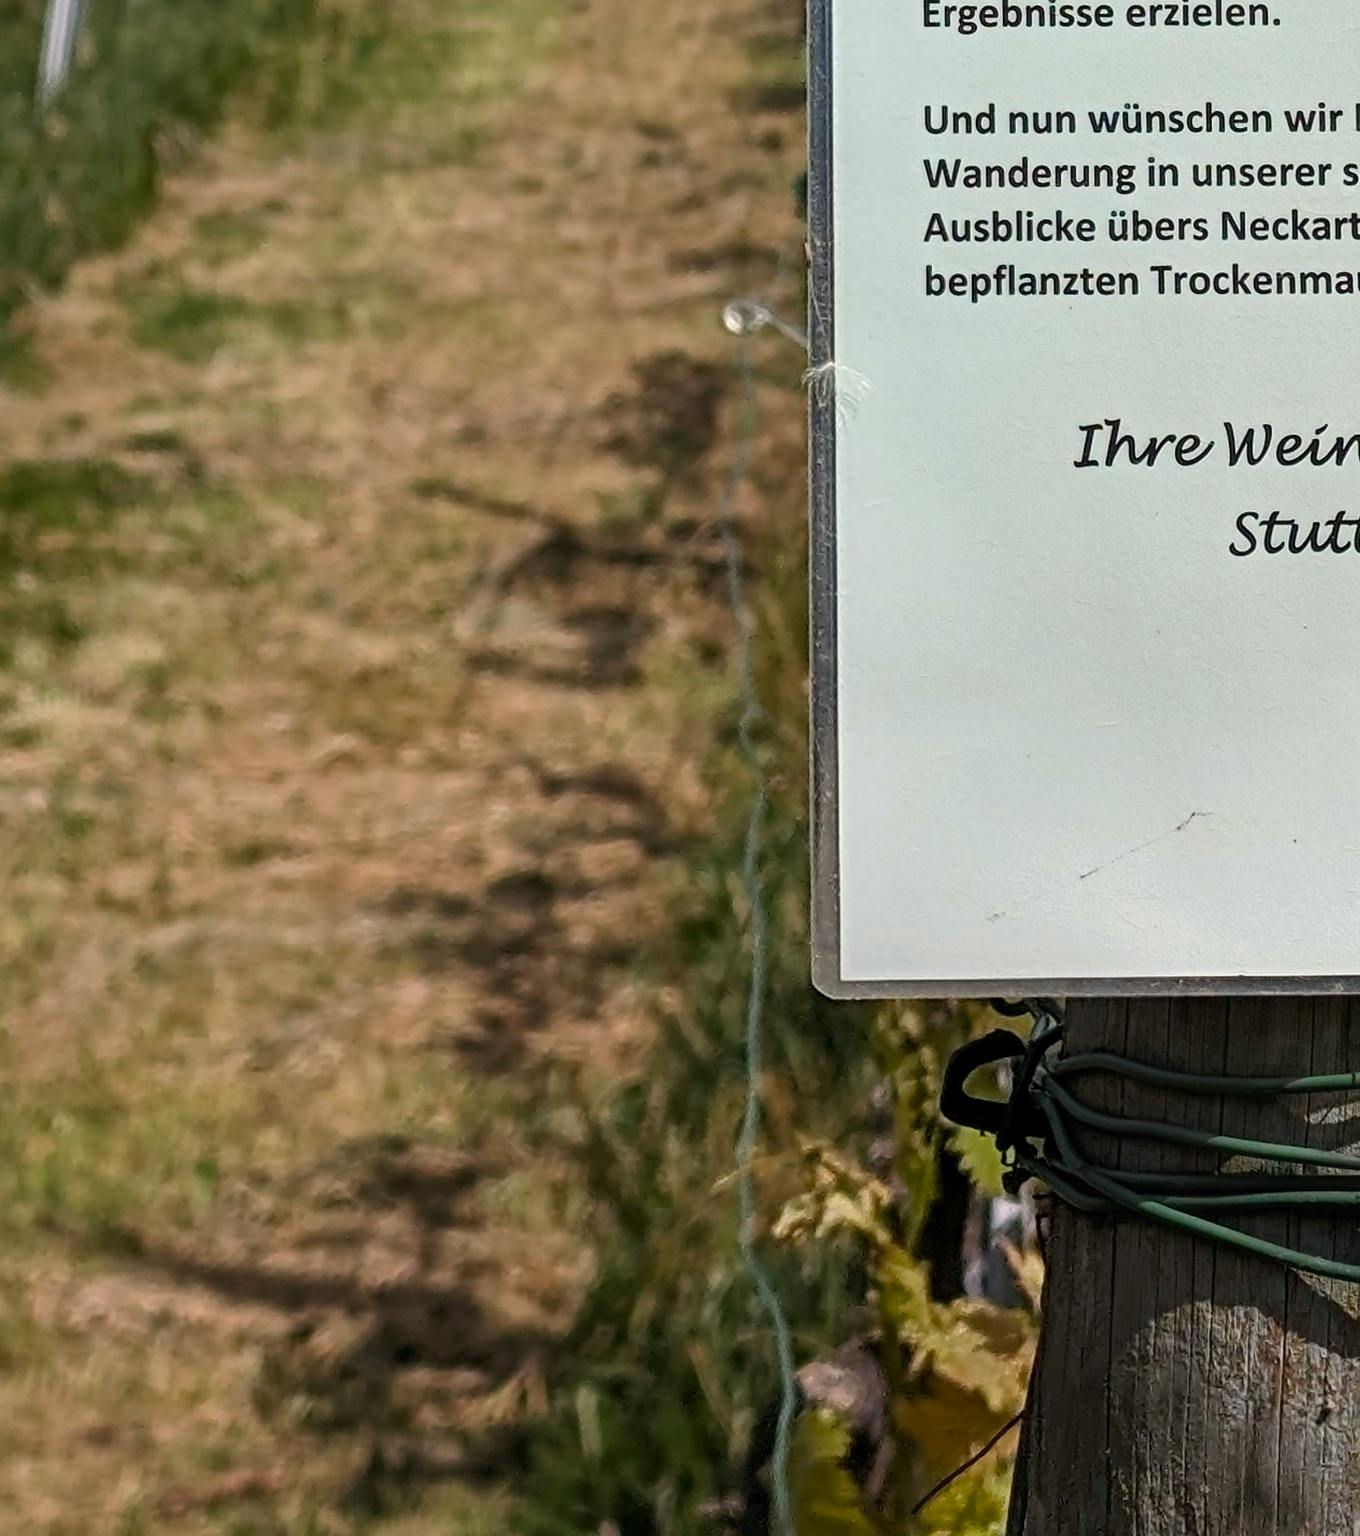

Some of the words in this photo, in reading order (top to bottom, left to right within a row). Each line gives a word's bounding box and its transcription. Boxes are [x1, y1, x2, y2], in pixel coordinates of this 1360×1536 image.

[924, 102, 996, 136] Und
[1008, 110, 1077, 135] nun
[1087, 101, 1273, 135] wünschen
[1283, 101, 1344, 133] wir
[922, 155, 1137, 194] Wanderung
[1146, 155, 1179, 188] in
[1192, 162, 1333, 188] unserer
[922, 209, 1097, 244] Ausblicke
[1107, 209, 1209, 243] übers
[925, 263, 1140, 304] bepflanzten
[1073, 418, 1216, 469] Ihre
